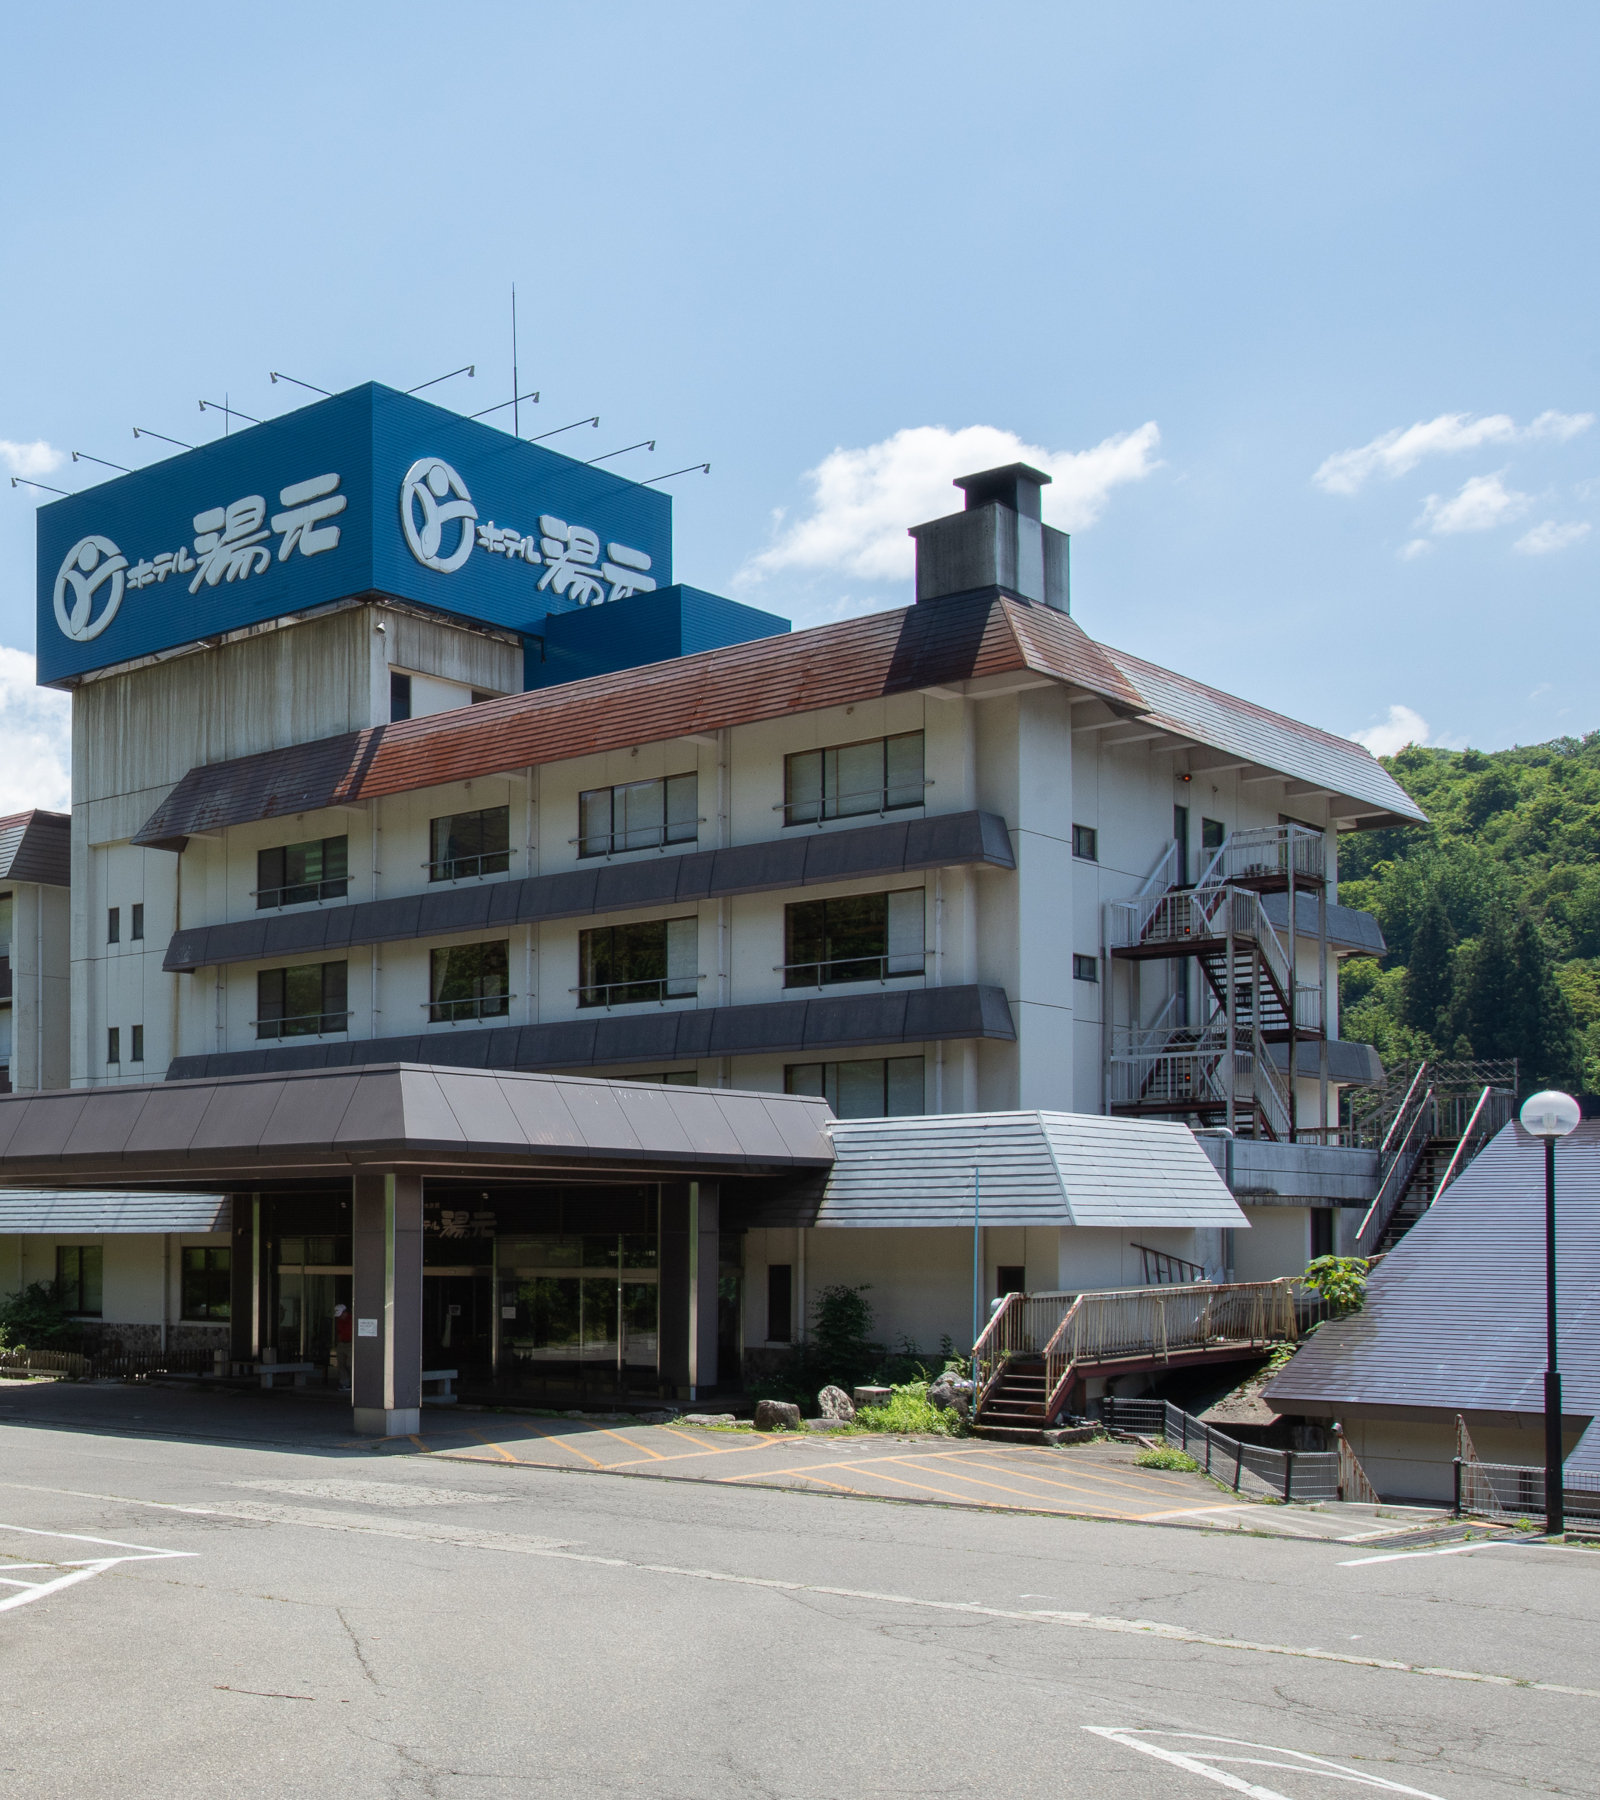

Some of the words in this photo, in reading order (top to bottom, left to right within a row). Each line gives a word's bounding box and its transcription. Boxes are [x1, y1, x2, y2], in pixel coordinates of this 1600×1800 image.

[126, 472, 348, 594] ホテル湯元
[423, 1210, 498, 1239] テル湯元
